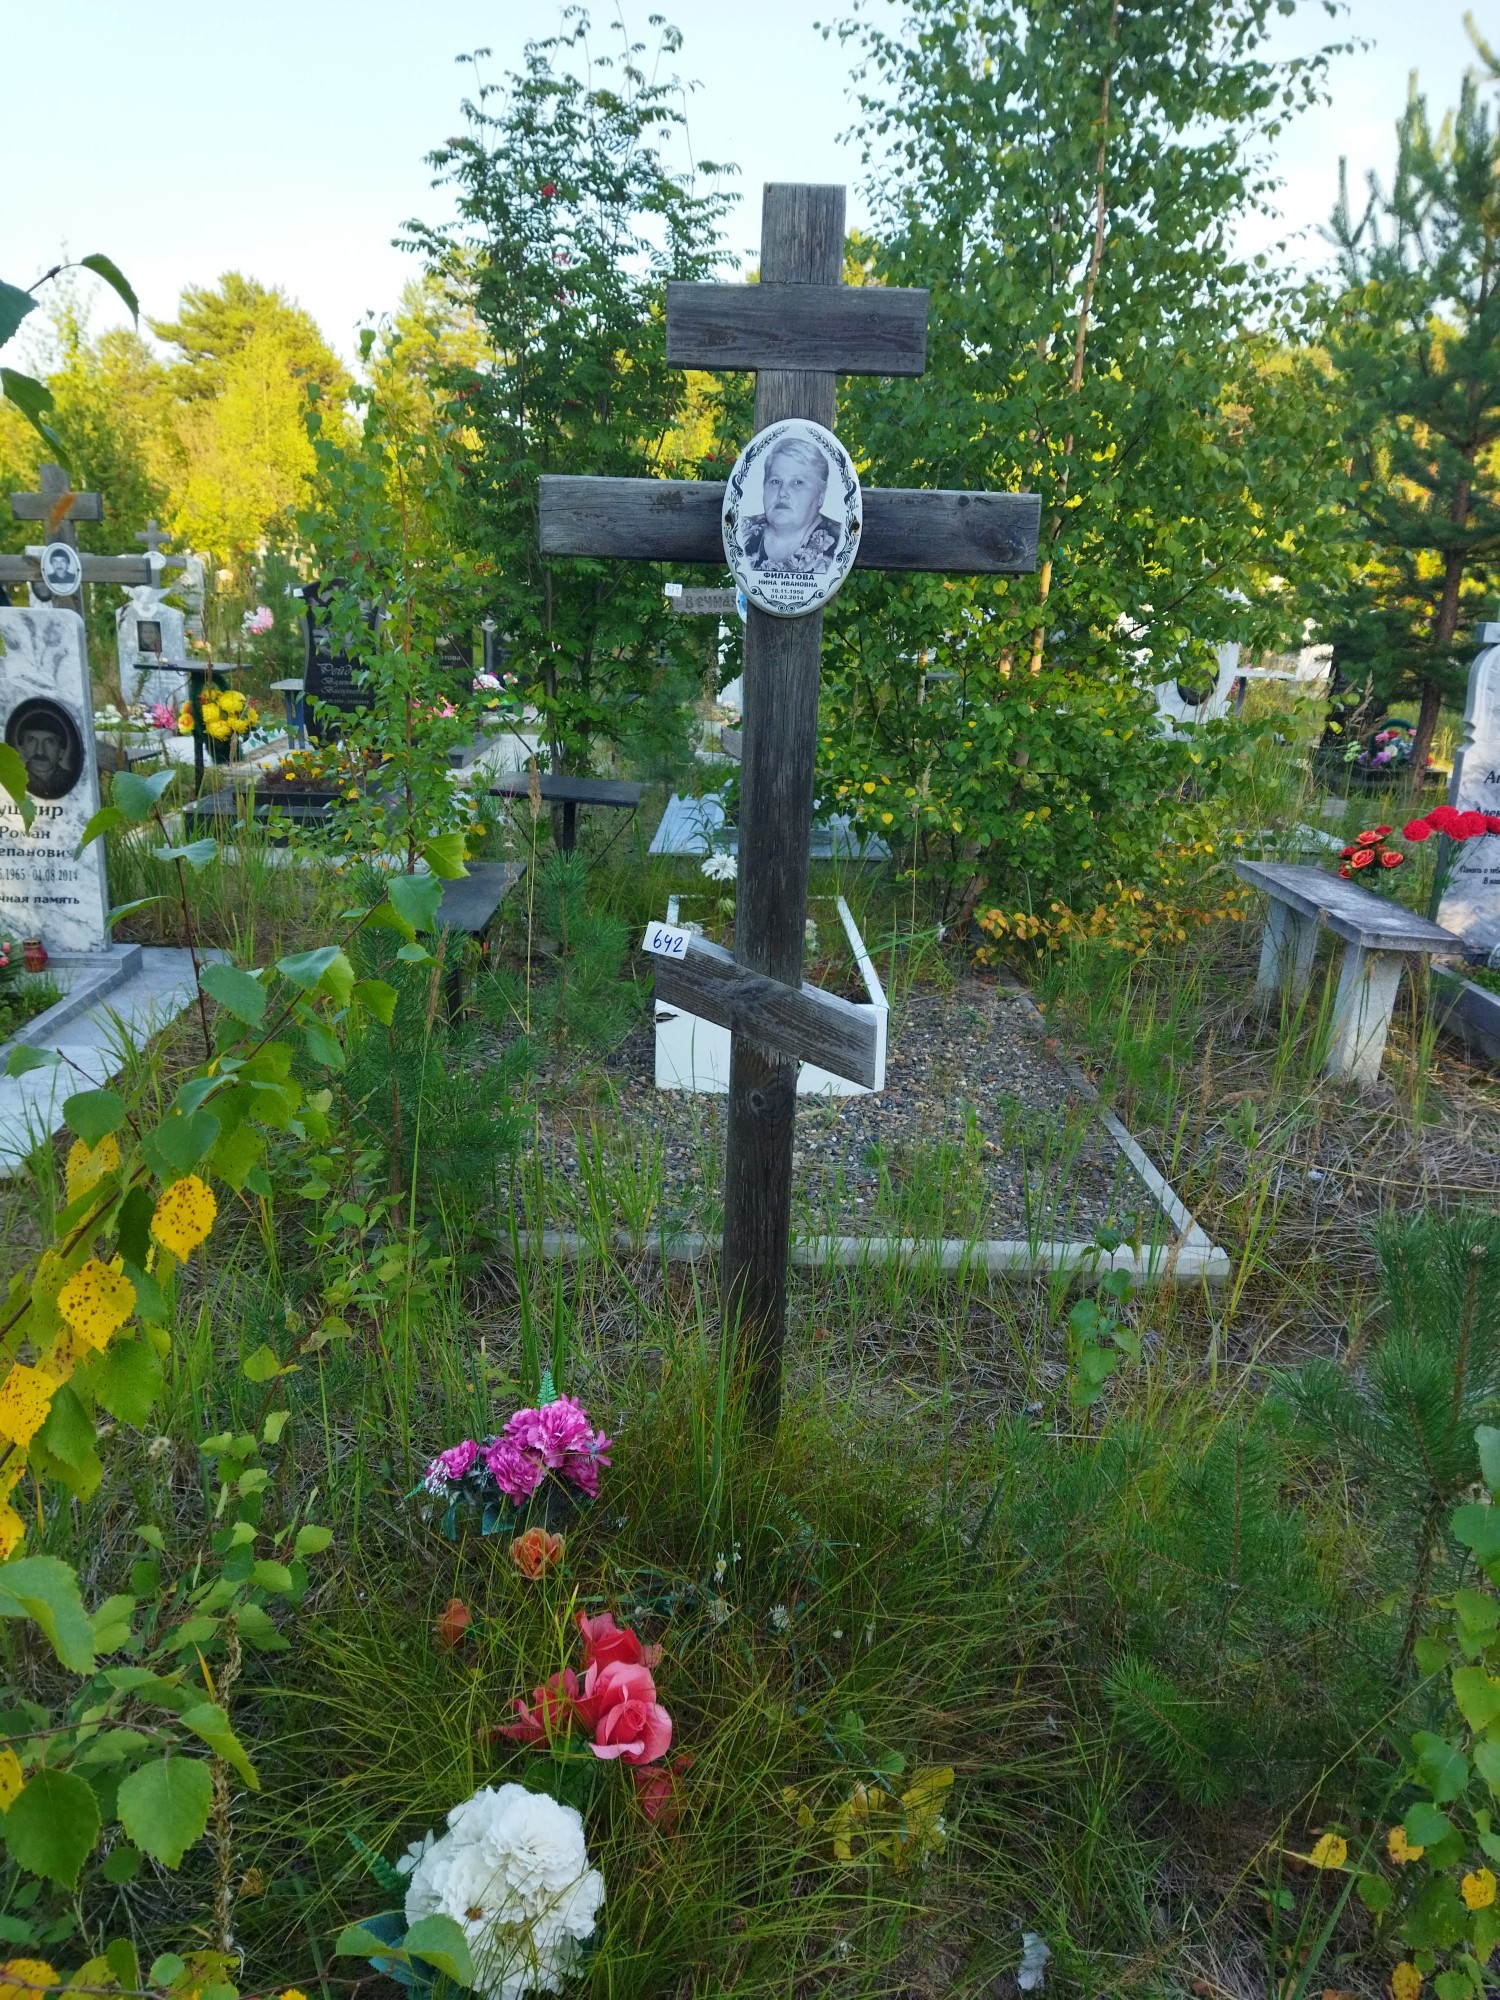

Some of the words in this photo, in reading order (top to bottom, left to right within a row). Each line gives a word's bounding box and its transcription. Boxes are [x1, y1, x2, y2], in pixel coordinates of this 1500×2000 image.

[763, 572, 815, 581] ФИЛАТОВА
[780, 580, 818, 588] ИВАНОВНА
[34, 895, 80, 905] память
[653, 929, 684, 953] 642
